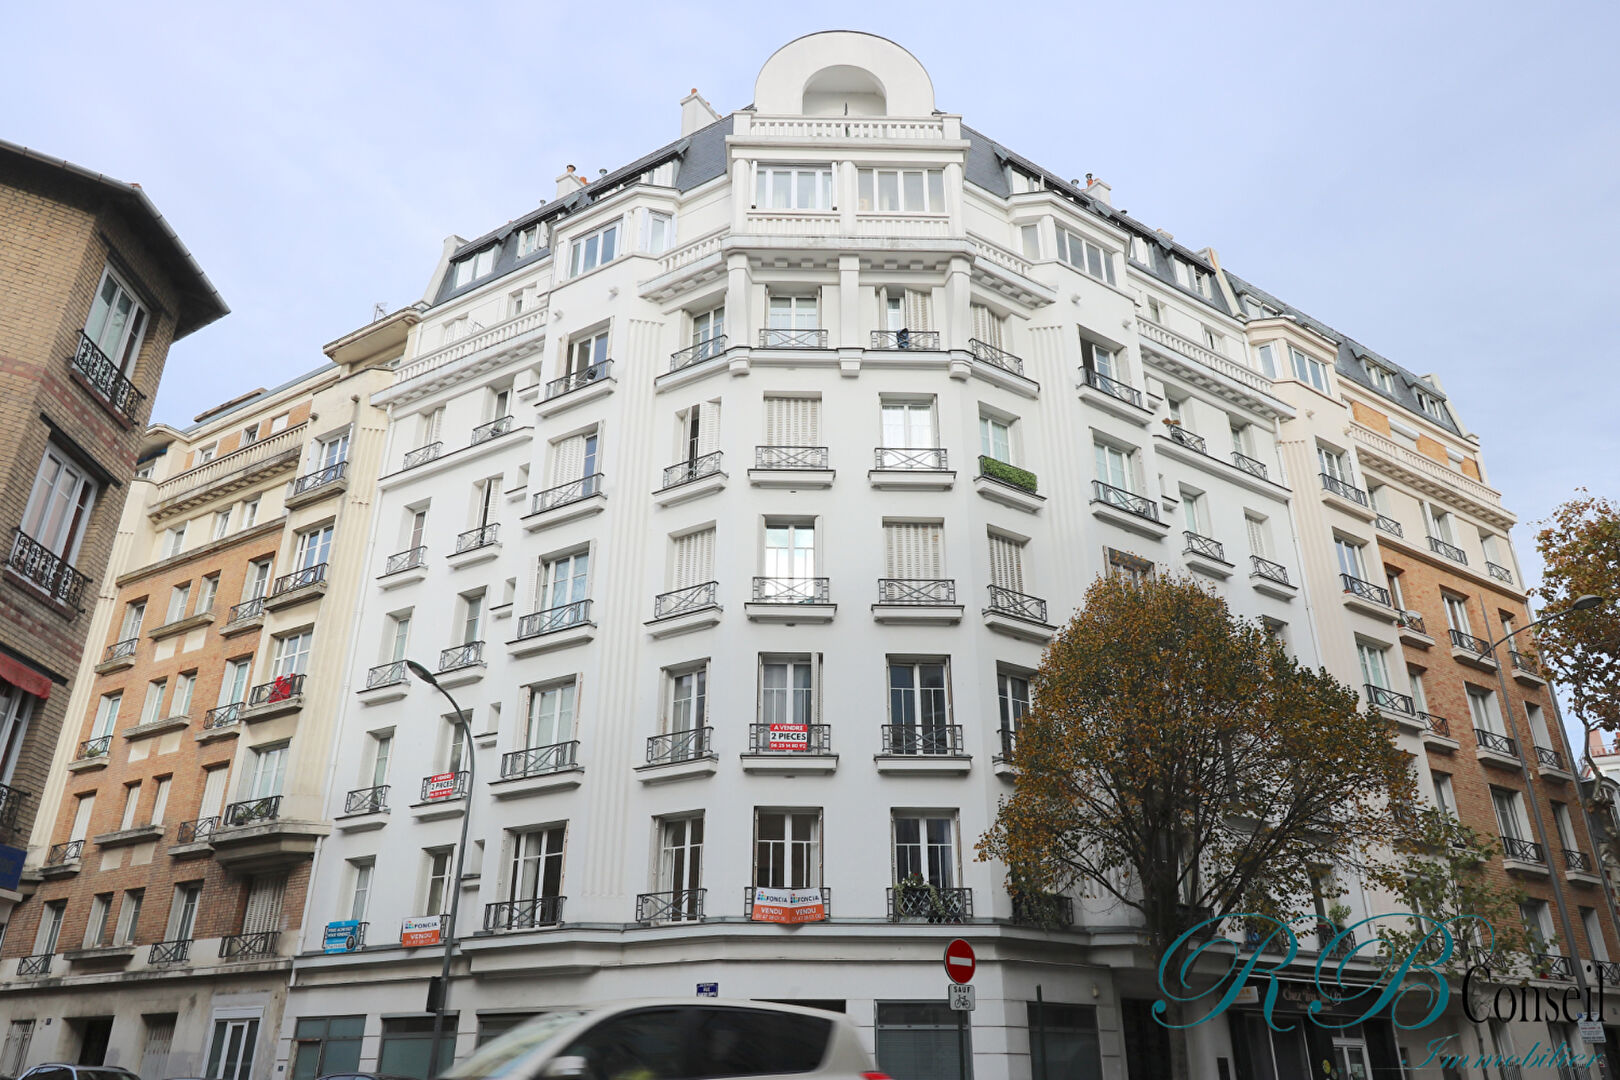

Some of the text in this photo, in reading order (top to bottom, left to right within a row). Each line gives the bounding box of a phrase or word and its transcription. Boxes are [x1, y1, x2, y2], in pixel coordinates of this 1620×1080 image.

[771, 732, 807, 741] 2 PIECES
[766, 895, 788, 903] FONCIA
[798, 895, 820, 903] FONCIA
[761, 907, 783, 915] VENDU
[795, 907, 817, 915] VENDU
[410, 932, 433, 940] VENDU
